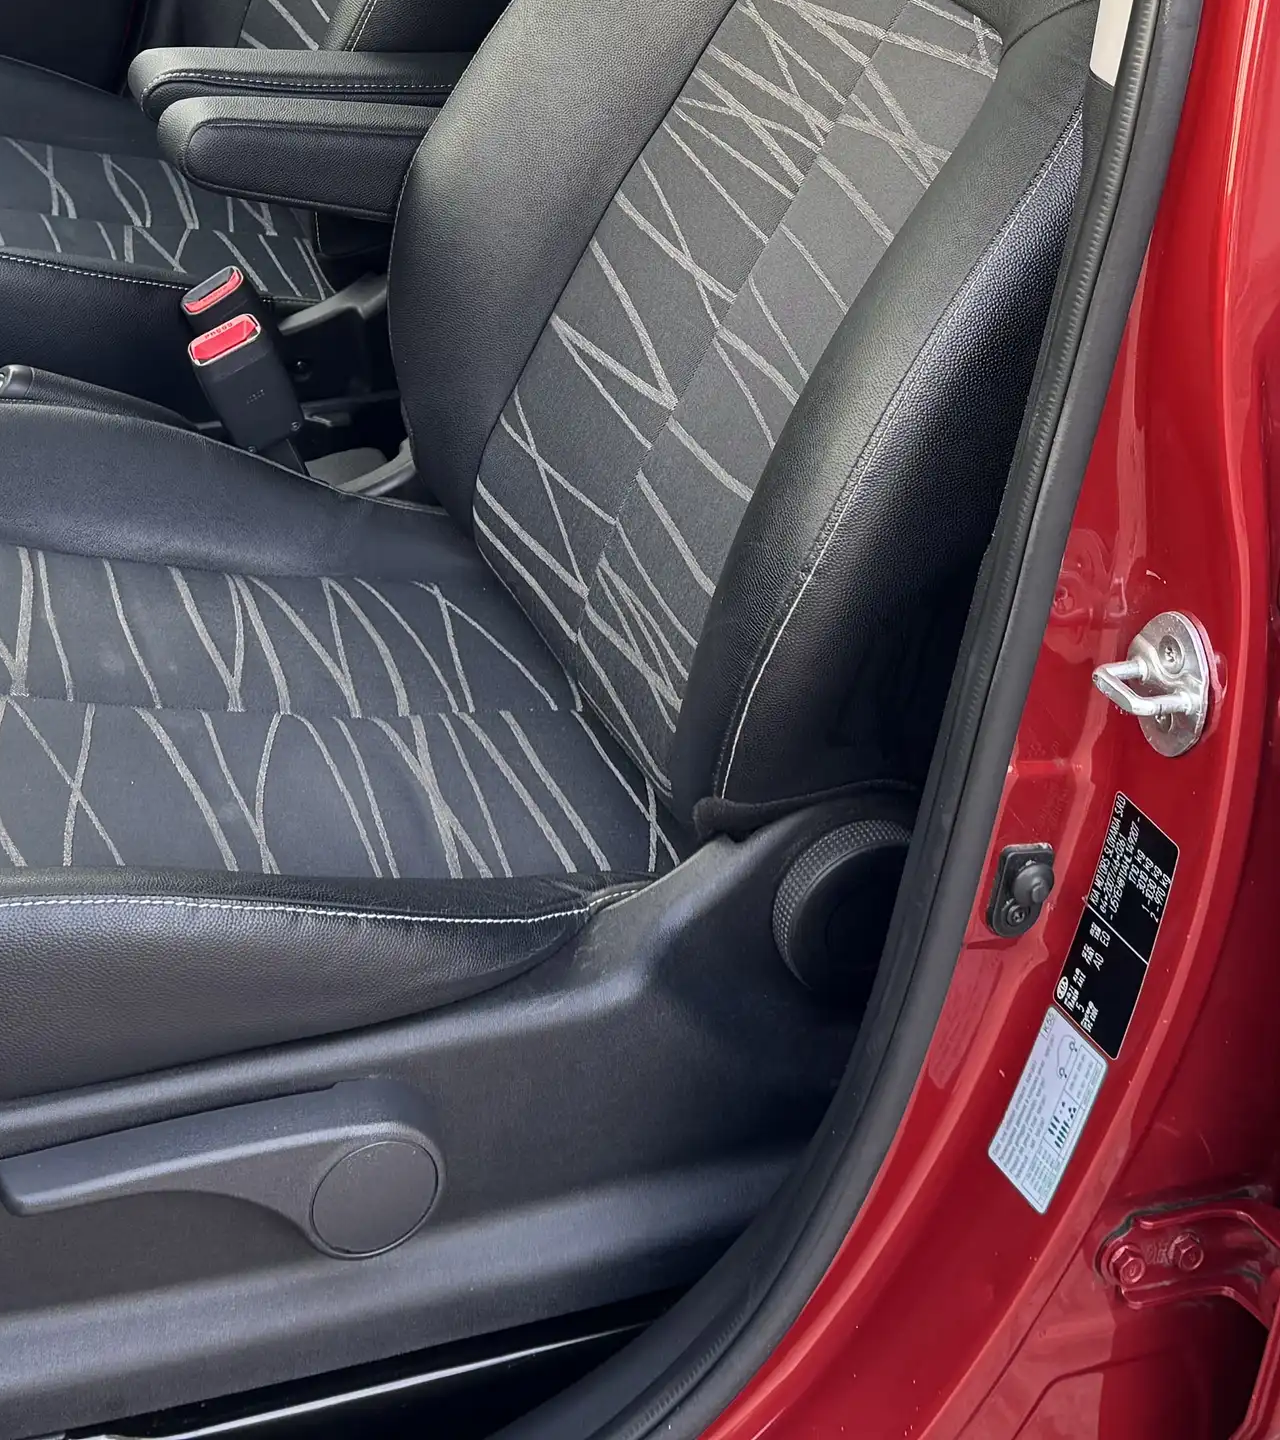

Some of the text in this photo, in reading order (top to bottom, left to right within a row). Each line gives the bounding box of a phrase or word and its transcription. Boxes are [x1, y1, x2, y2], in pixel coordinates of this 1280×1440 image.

[1133, 848, 1146, 865] kg
[1142, 856, 1155, 874] kg
[1093, 854, 1111, 891] MOTORS
[1150, 864, 1163, 883] kg
[1159, 873, 1172, 889] kg
[1089, 888, 1101, 906] KIA
